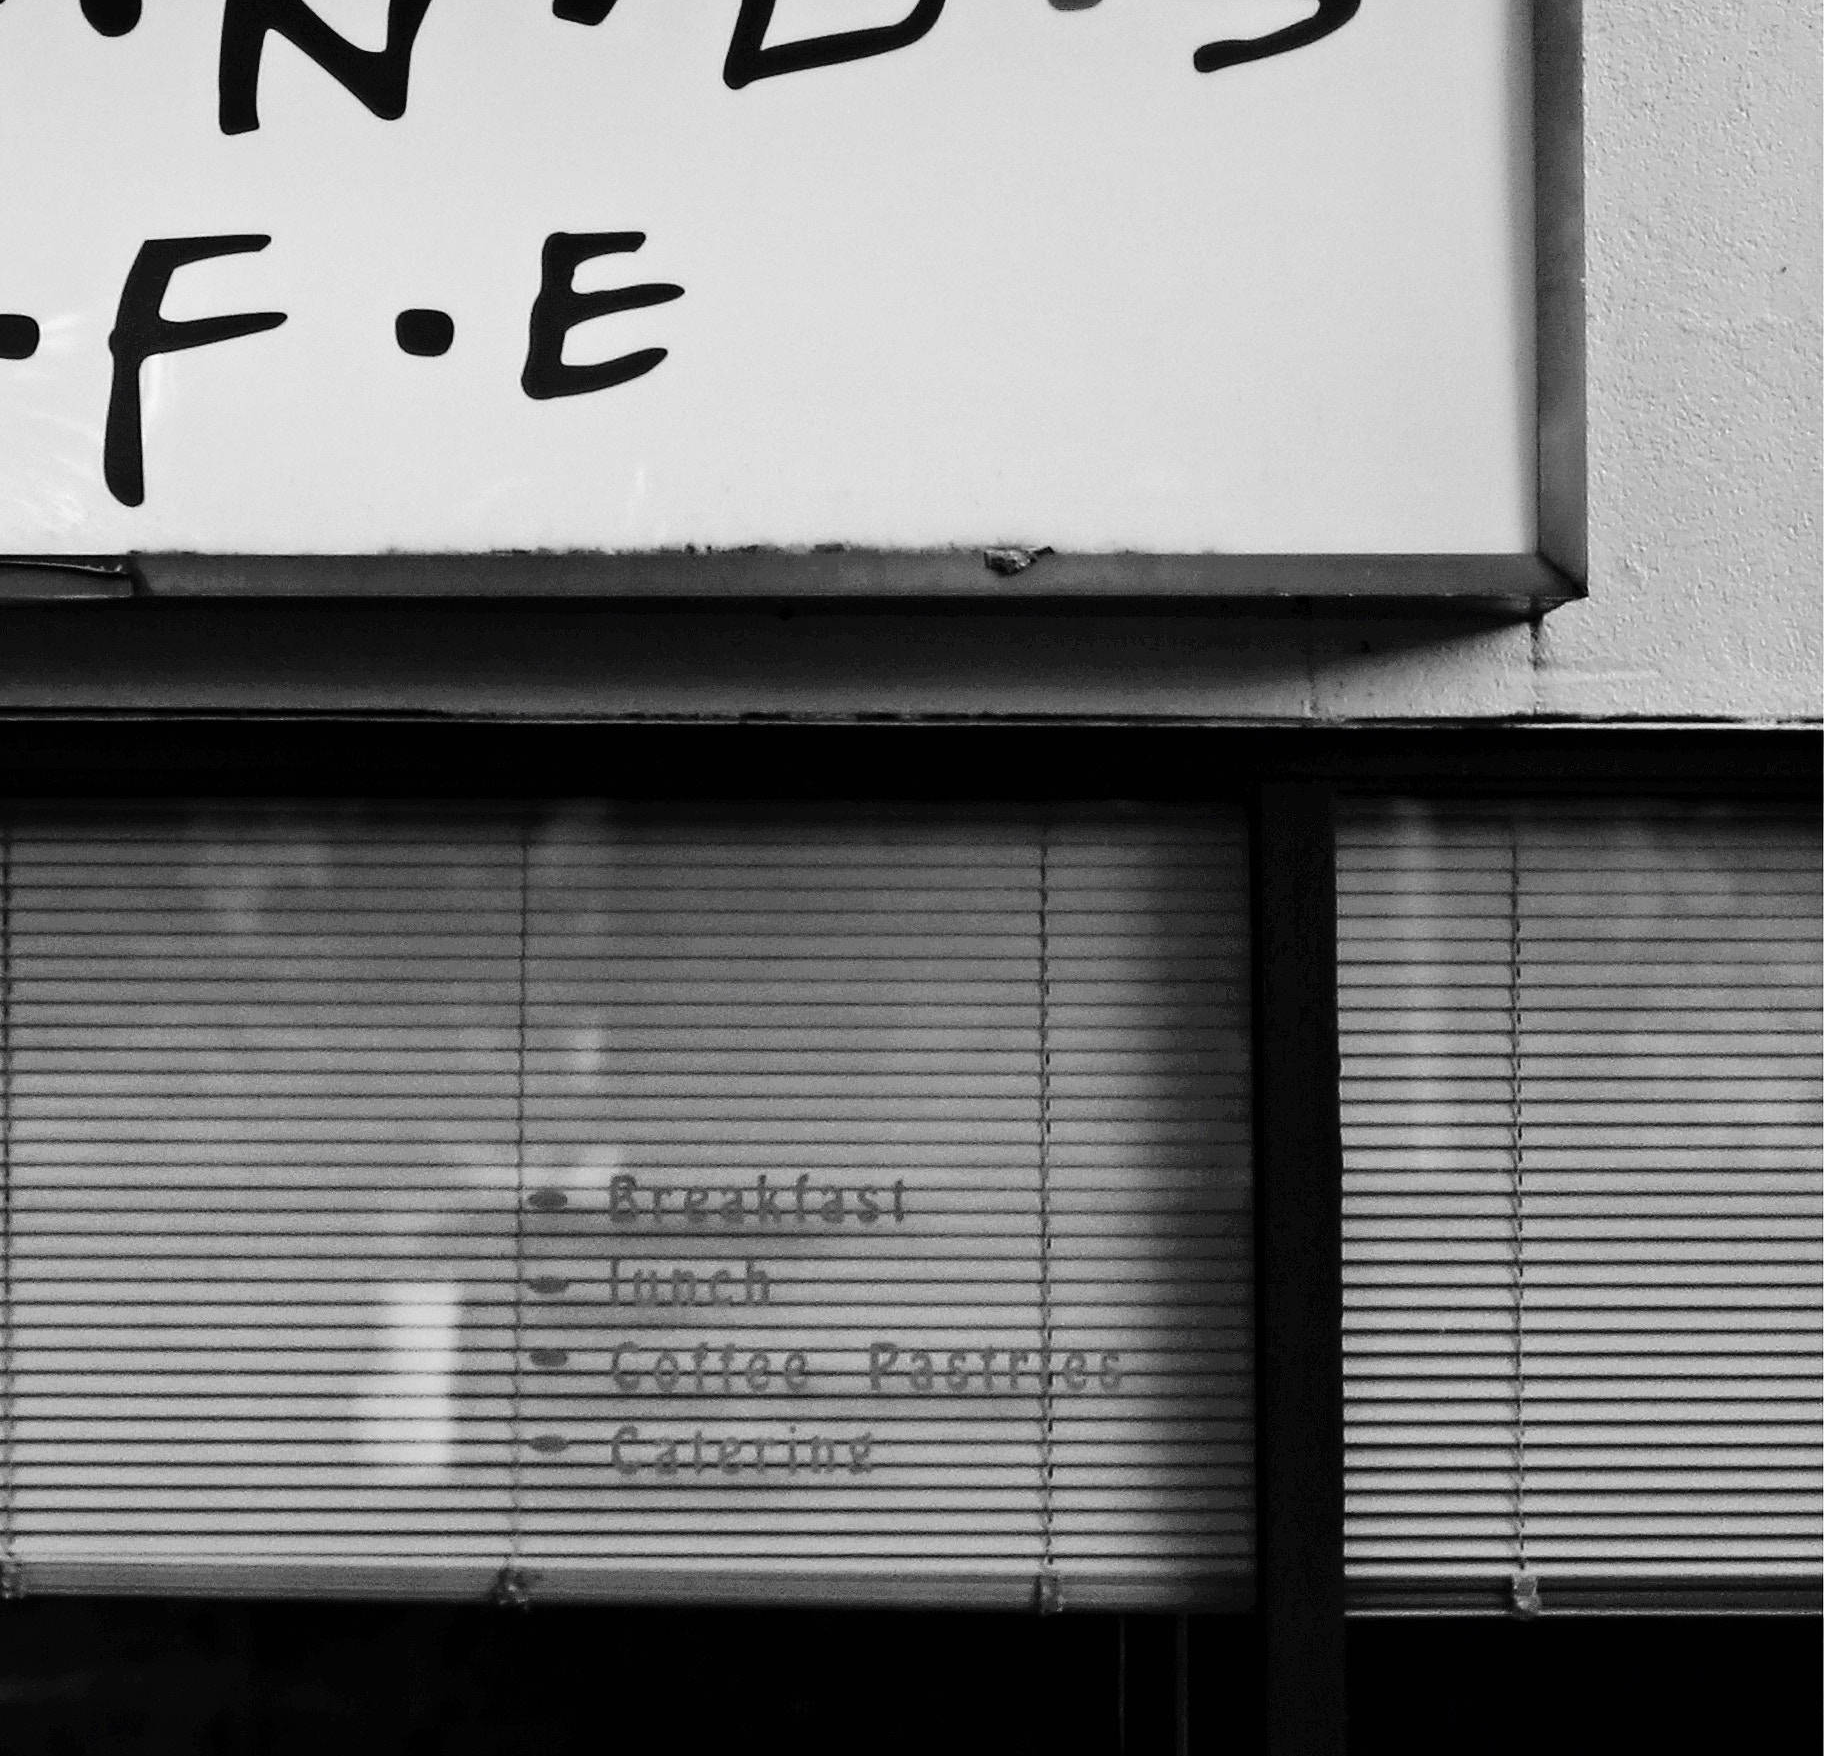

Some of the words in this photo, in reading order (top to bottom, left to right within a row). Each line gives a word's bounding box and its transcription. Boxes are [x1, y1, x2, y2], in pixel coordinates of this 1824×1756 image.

[608, 1173, 905, 1224] Breakfast
[610, 1341, 808, 1393] Coffee
[869, 1342, 1122, 1393] Pastries
[610, 1424, 873, 1476] Catering
